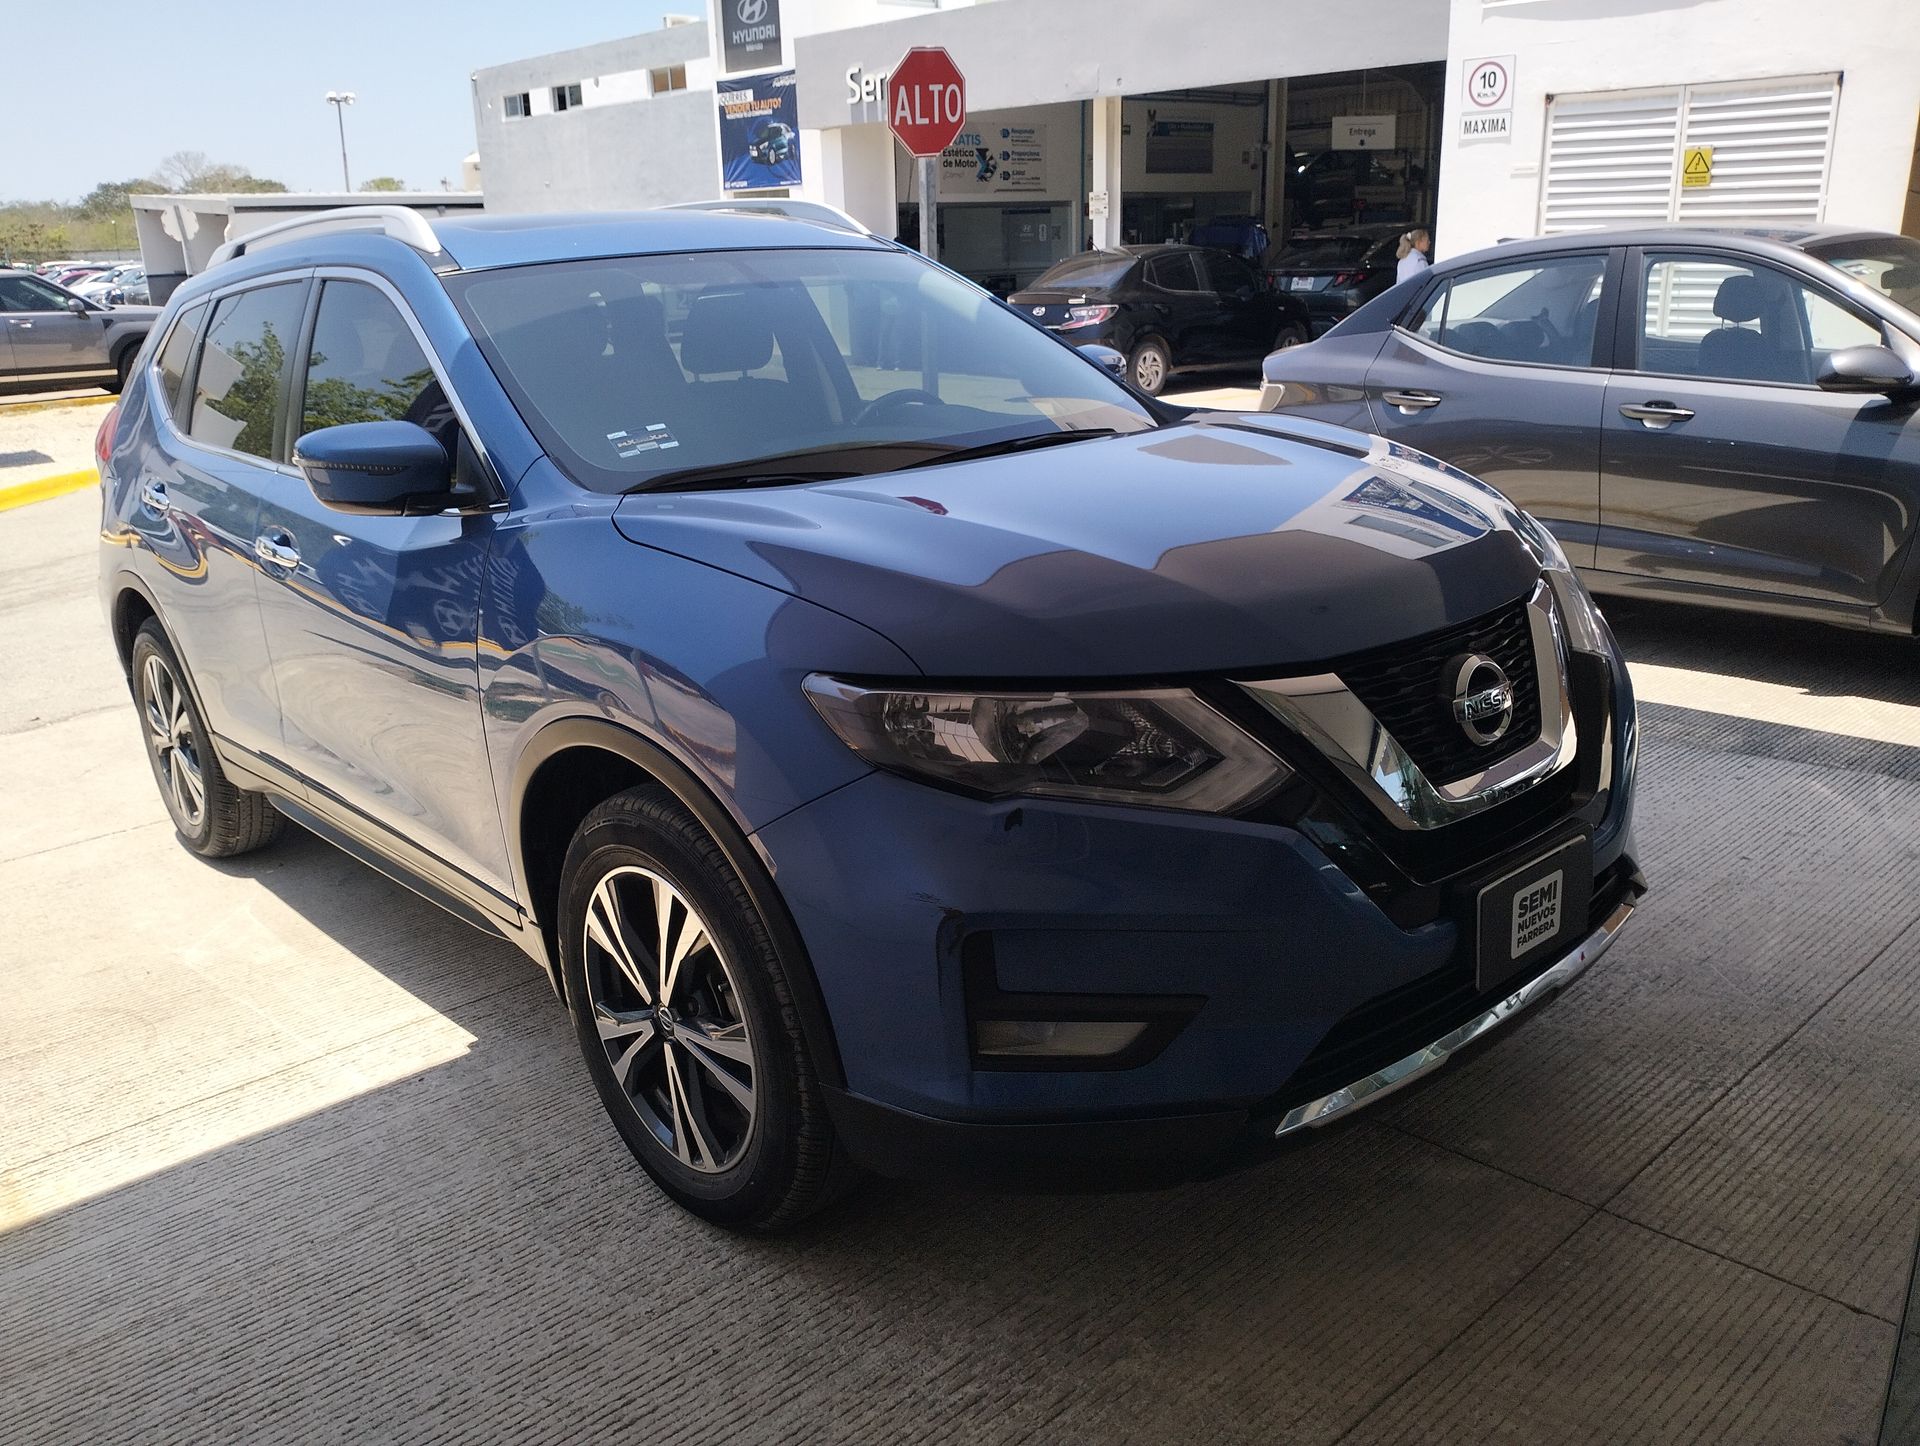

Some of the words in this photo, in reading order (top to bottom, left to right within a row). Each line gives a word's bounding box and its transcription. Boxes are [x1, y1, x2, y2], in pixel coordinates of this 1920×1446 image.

[733, 24, 775, 44] HYUNDAI
[846, 65, 889, 104] Ser
[1480, 71, 1497, 89] 10
[894, 83, 962, 125] ALTO
[1349, 128, 1376, 138] Entrega
[1464, 118, 1506, 135] MAXIMA
[943, 158, 953, 168] de
[955, 158, 978, 168] Motor
[1518, 880, 1558, 918] SEMI
[1517, 903, 1556, 934] NUEVOS
[1517, 919, 1555, 949] FARRERA
